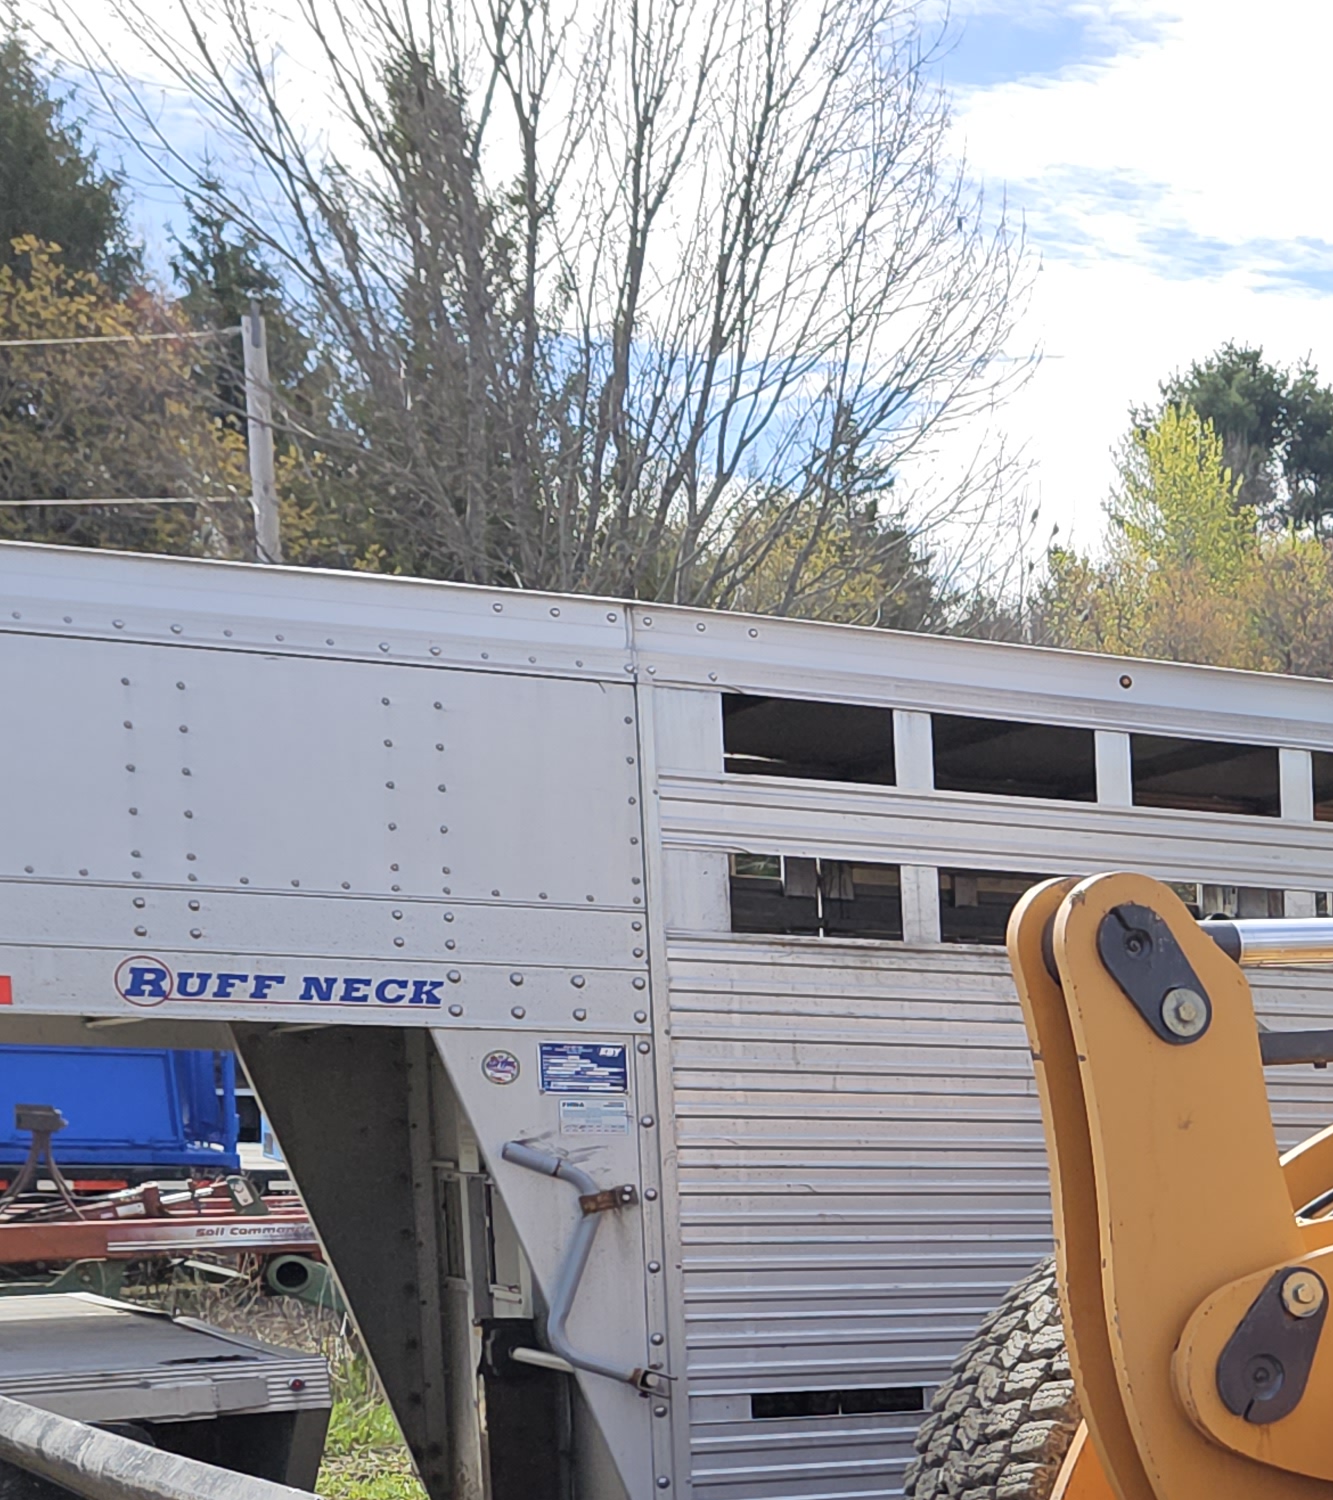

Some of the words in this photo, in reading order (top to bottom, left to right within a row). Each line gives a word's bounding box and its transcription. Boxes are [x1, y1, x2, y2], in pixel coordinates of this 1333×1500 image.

[124, 966, 286, 999] RUFF
[299, 977, 444, 1005] NECK
[195, 1227, 225, 1237] Soil
